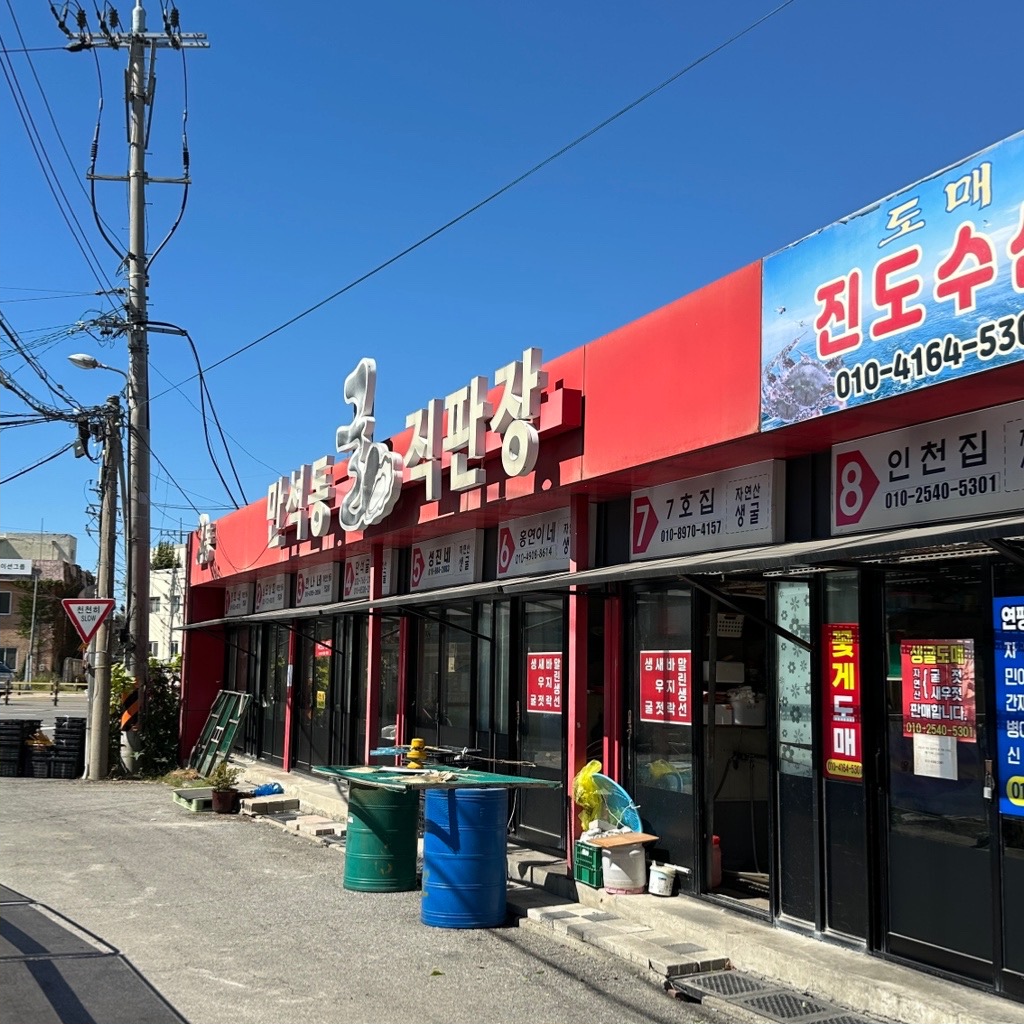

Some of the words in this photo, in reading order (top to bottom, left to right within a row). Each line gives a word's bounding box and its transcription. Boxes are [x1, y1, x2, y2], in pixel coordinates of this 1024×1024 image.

[878, 161, 992, 249] 도매
[814, 200, 1024, 361] 진도수
[267, 455, 336, 549] 만석동
[403, 347, 548, 501] 직판장
[887, 430, 987, 483] 인천집
[735, 483, 761, 502] 자연산
[840, 461, 864, 517] 8
[885, 474, 996, 509] 010-2540-5301
[636, 504, 650, 547] 7
[660, 520, 722, 543] 010-8970-4157
[735, 501, 760, 528] 생굴
[500, 534, 510, 568] 6
[77, 605, 101, 614] 천천히
[906, 722, 973, 737] 010-2540-5301
